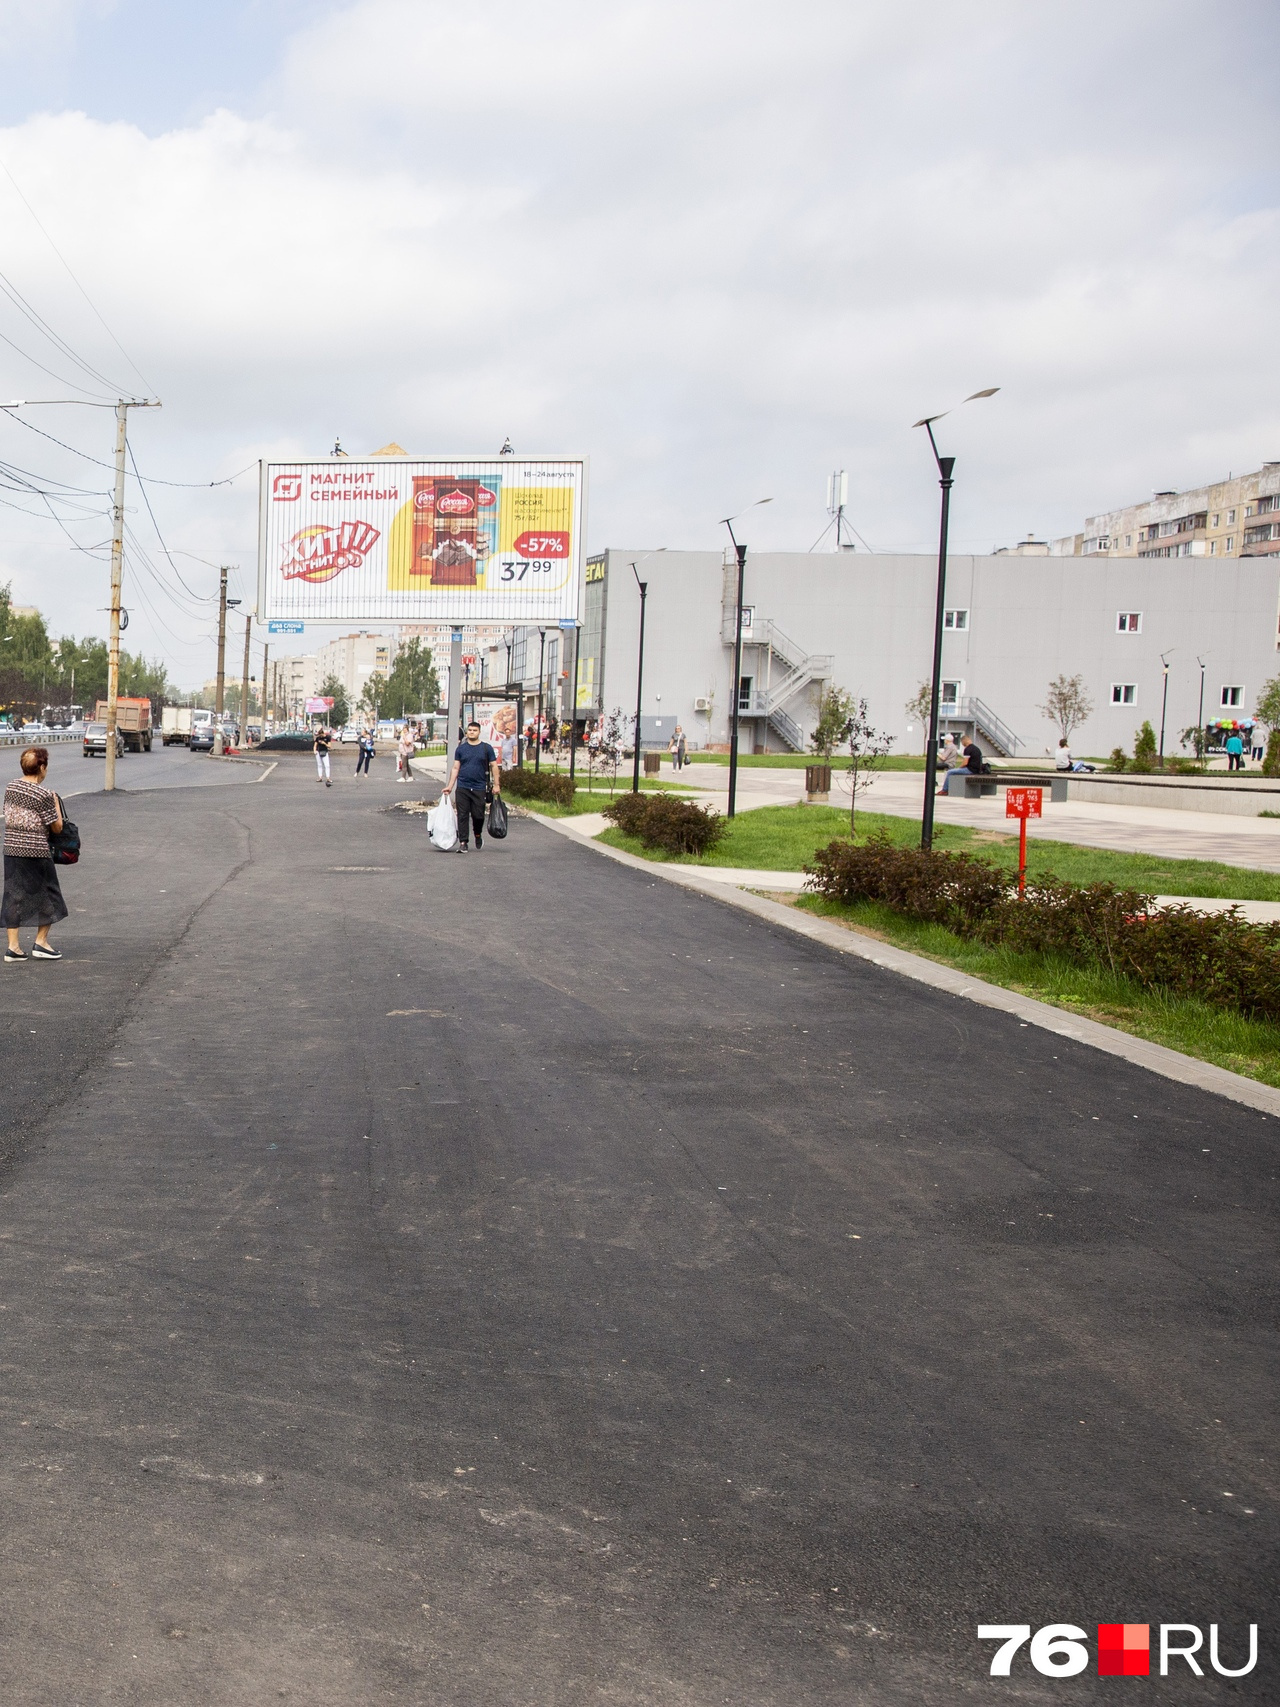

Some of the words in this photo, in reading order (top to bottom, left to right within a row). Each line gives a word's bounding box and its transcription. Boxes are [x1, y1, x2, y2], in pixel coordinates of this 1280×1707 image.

[310, 472, 375, 484] МАГНИТ
[310, 486, 399, 501] СЕМЕЙНЫЙ
[520, 538, 563, 552] -57%
[282, 552, 337, 578] МАГНИТ
